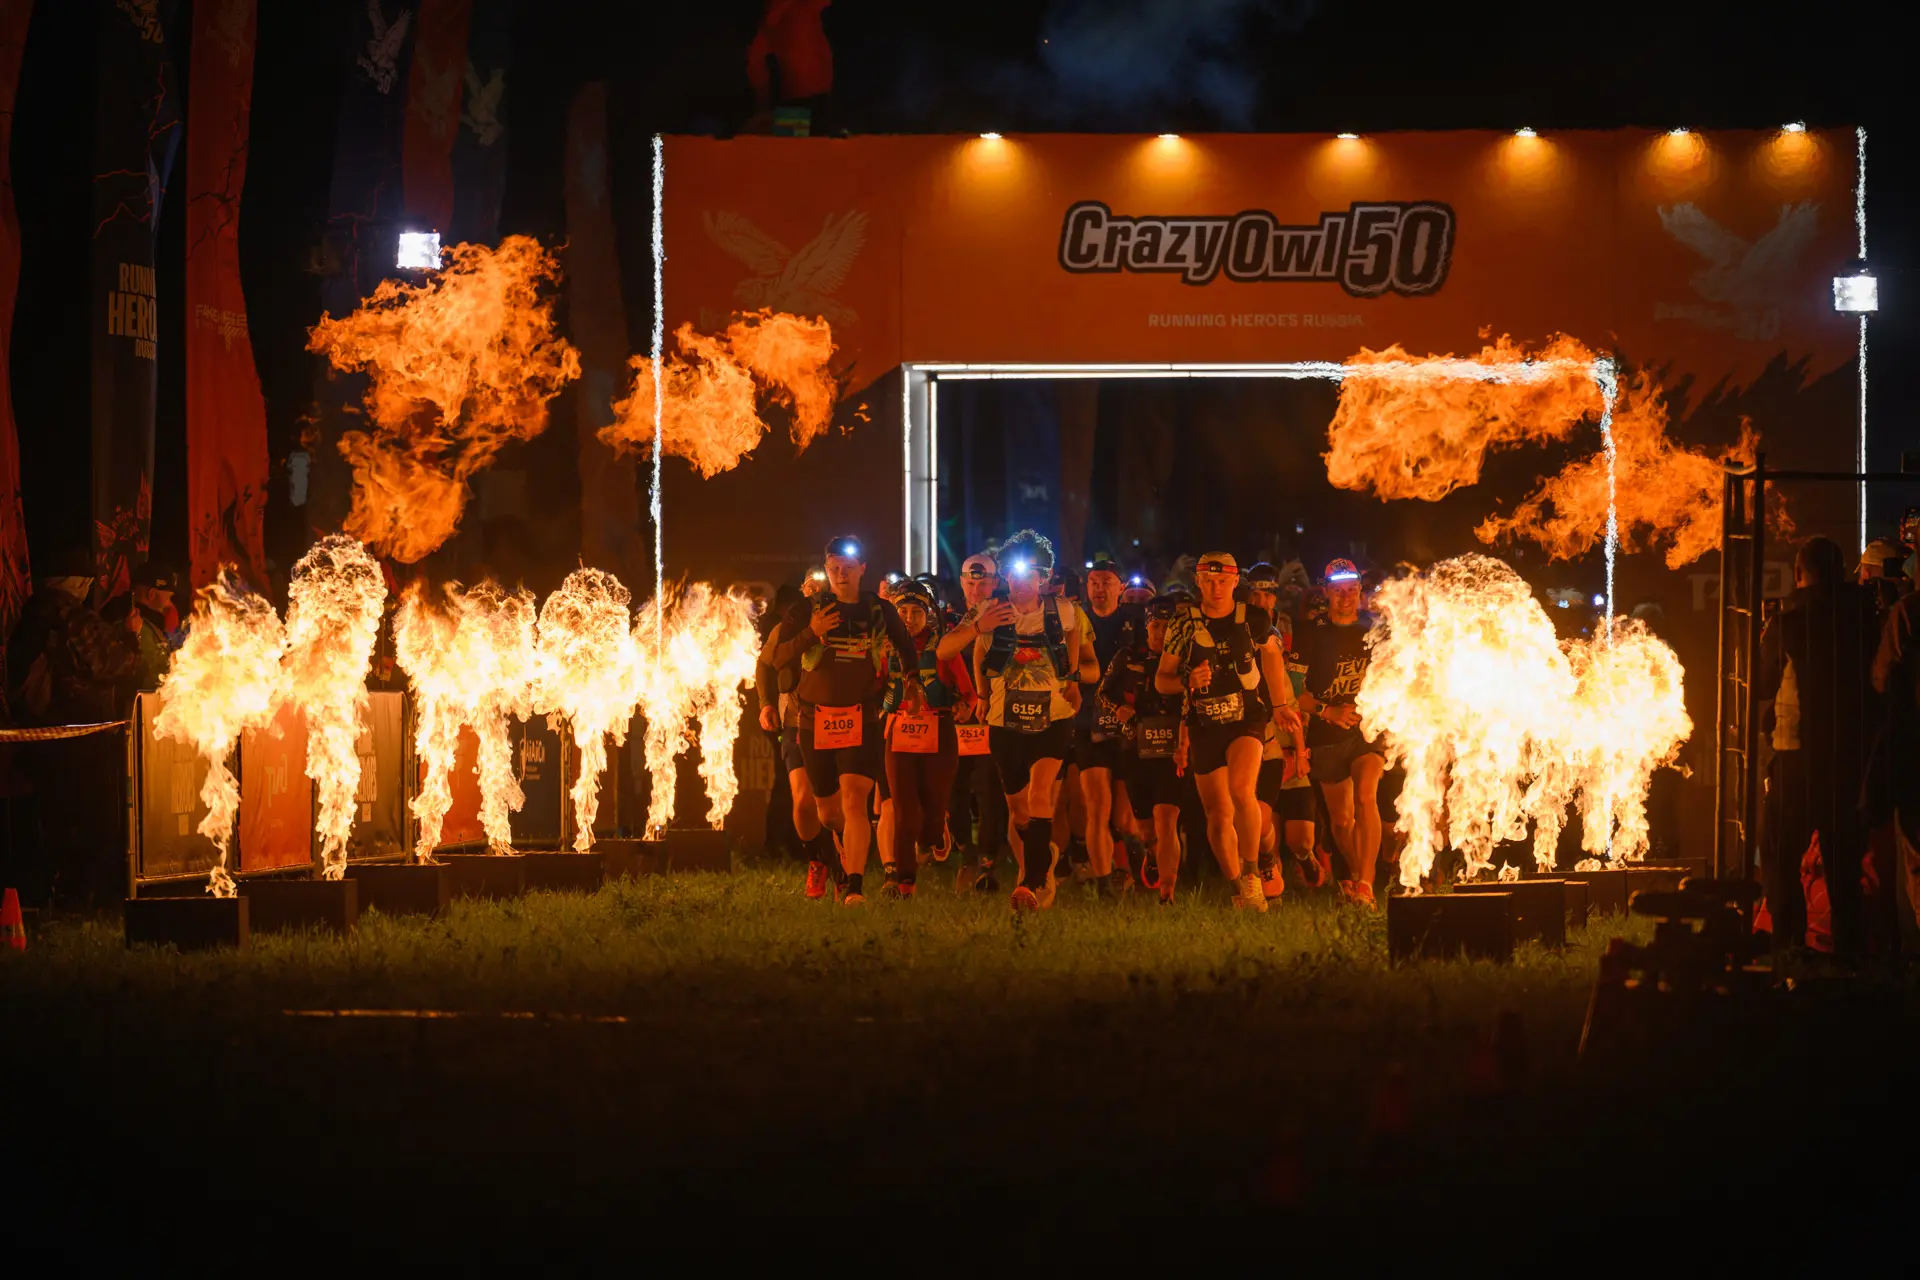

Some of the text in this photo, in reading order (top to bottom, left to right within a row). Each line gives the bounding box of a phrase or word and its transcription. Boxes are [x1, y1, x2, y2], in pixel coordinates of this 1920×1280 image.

[108, 291, 157, 342] HERO
[1149, 313, 1226, 328] RUNNING
[1231, 313, 1298, 328] HEROES
[1012, 703, 1042, 715] 6154
[823, 719, 854, 731] 2108
[901, 723, 929, 734] 2977
[960, 729, 985, 738] 2514
[1144, 729, 1173, 740] 5195
